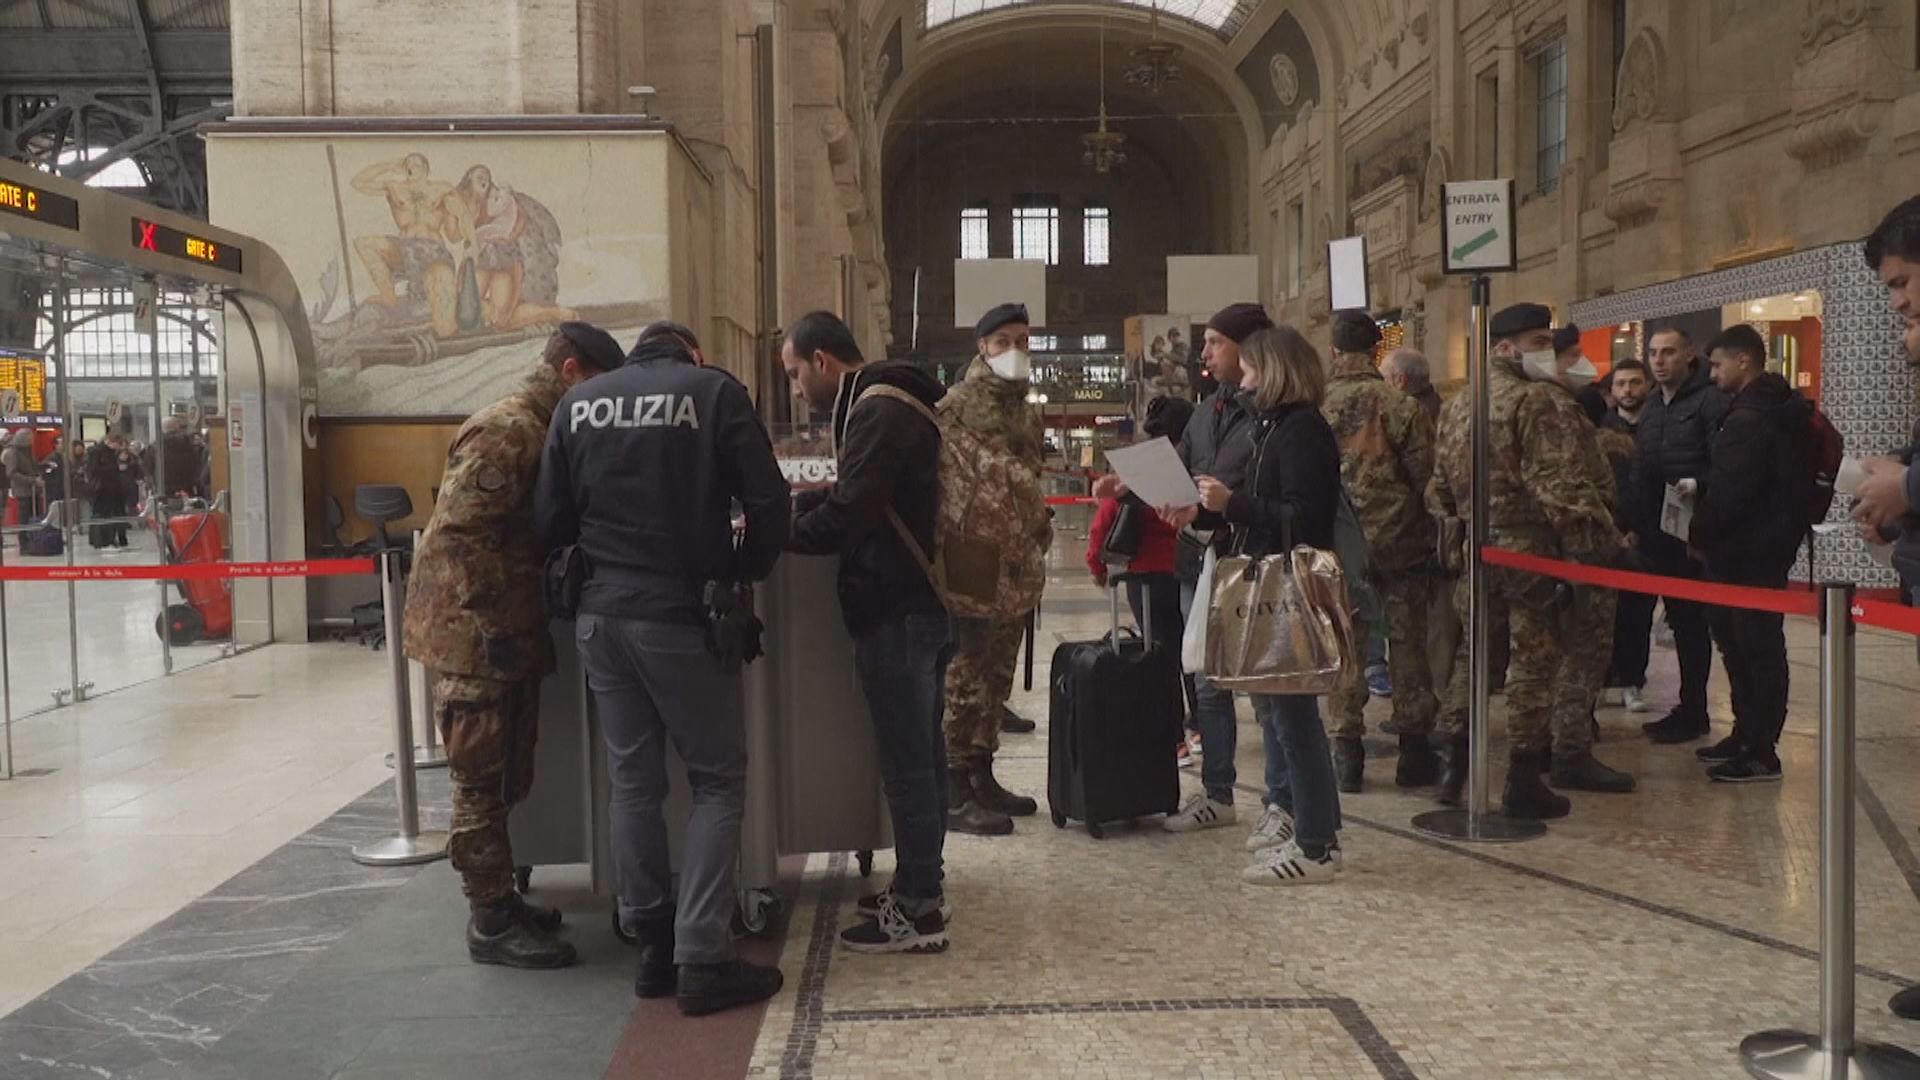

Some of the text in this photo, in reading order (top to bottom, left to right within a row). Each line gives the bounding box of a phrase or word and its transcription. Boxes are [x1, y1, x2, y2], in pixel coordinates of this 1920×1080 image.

[0, 183, 36, 211] ATE C
[1446, 192, 1500, 205] ENTRATA
[1455, 213, 1493, 225] ENTRY
[186, 238, 216, 261] GATE C
[1075, 390, 1103, 400] MAIO
[570, 394, 699, 433] POLIZIA
